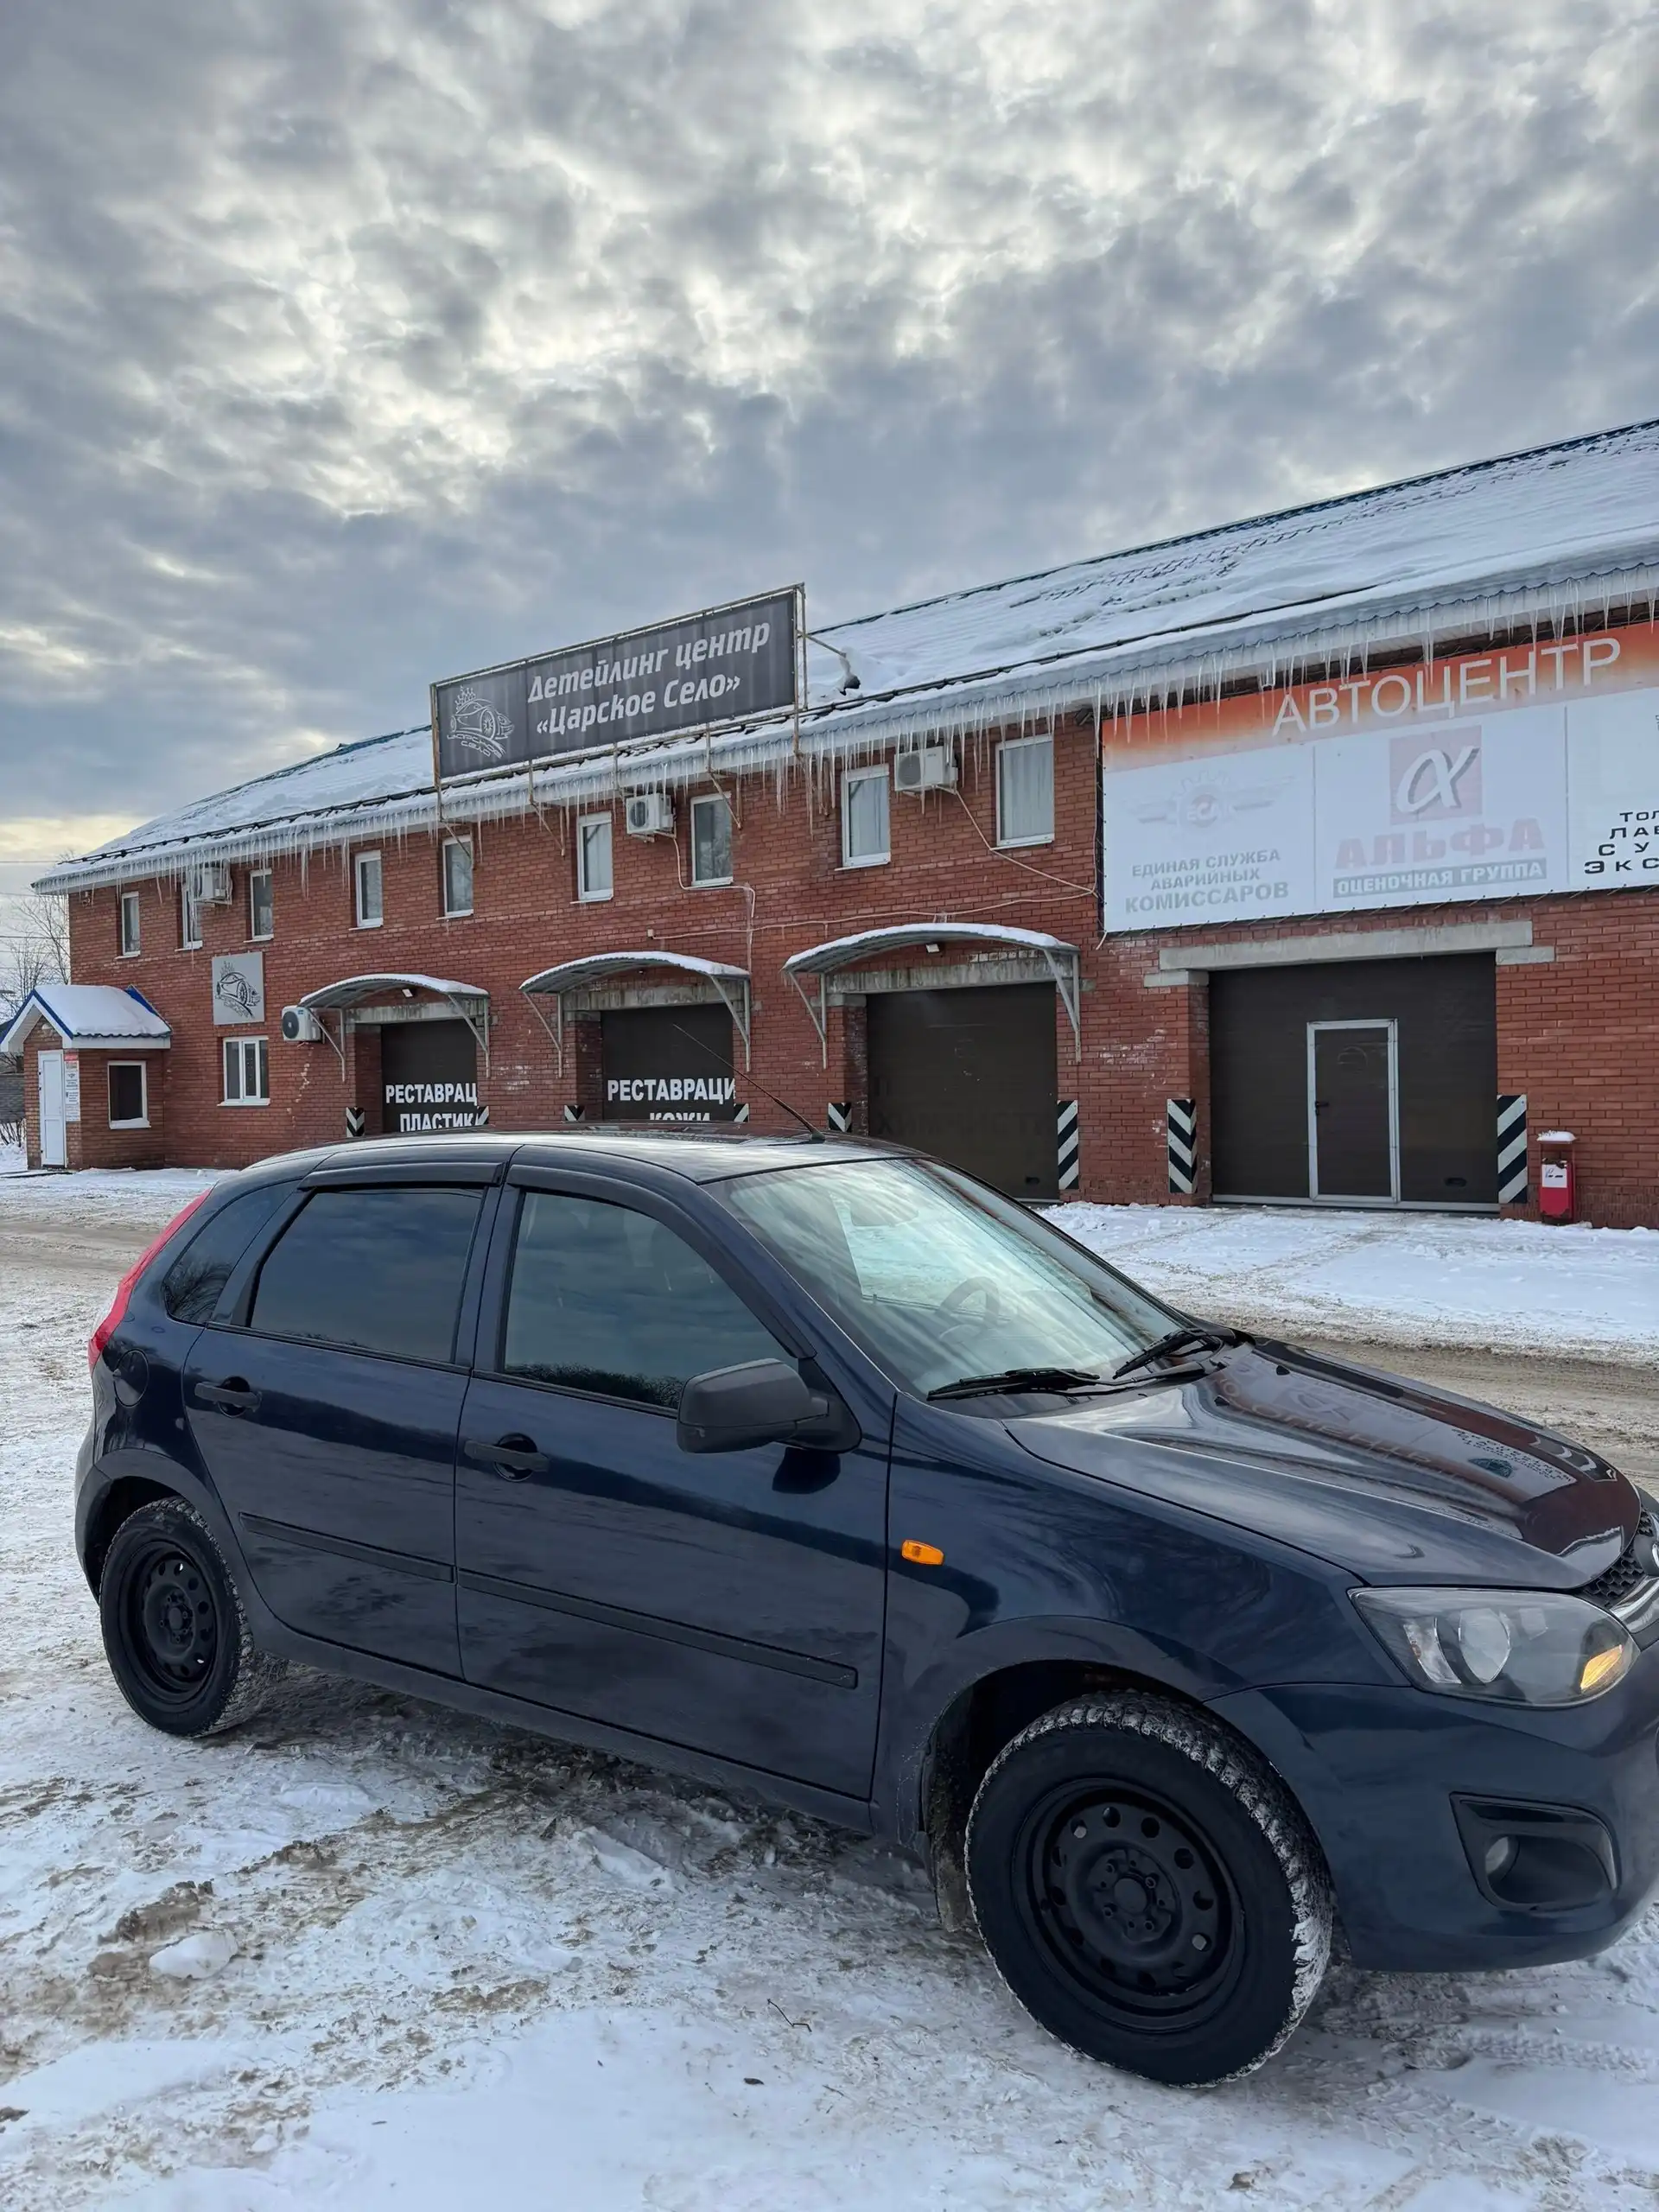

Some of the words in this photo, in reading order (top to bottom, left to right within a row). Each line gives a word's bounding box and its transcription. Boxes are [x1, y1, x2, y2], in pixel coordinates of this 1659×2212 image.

[527, 648, 669, 703] Детейлинг
[676, 622, 770, 670] центр
[537, 691, 656, 734] «Царское
[664, 674, 741, 709] Село»
[1272, 638, 1621, 736] АВТОЦЕНТР
[1132, 858, 1199, 878] ЕДИНАЯ
[1205, 849, 1281, 868] СЛУЖБА
[1335, 817, 1545, 869] АЛЬФА
[1125, 881, 1289, 914] КОМИССАРОВ
[1151, 868, 1261, 891] АВАРИЙНЫХ
[1337, 871, 1453, 895] ОЦЕНОЧНАЯ
[1460, 862, 1542, 883] ГРУППА
